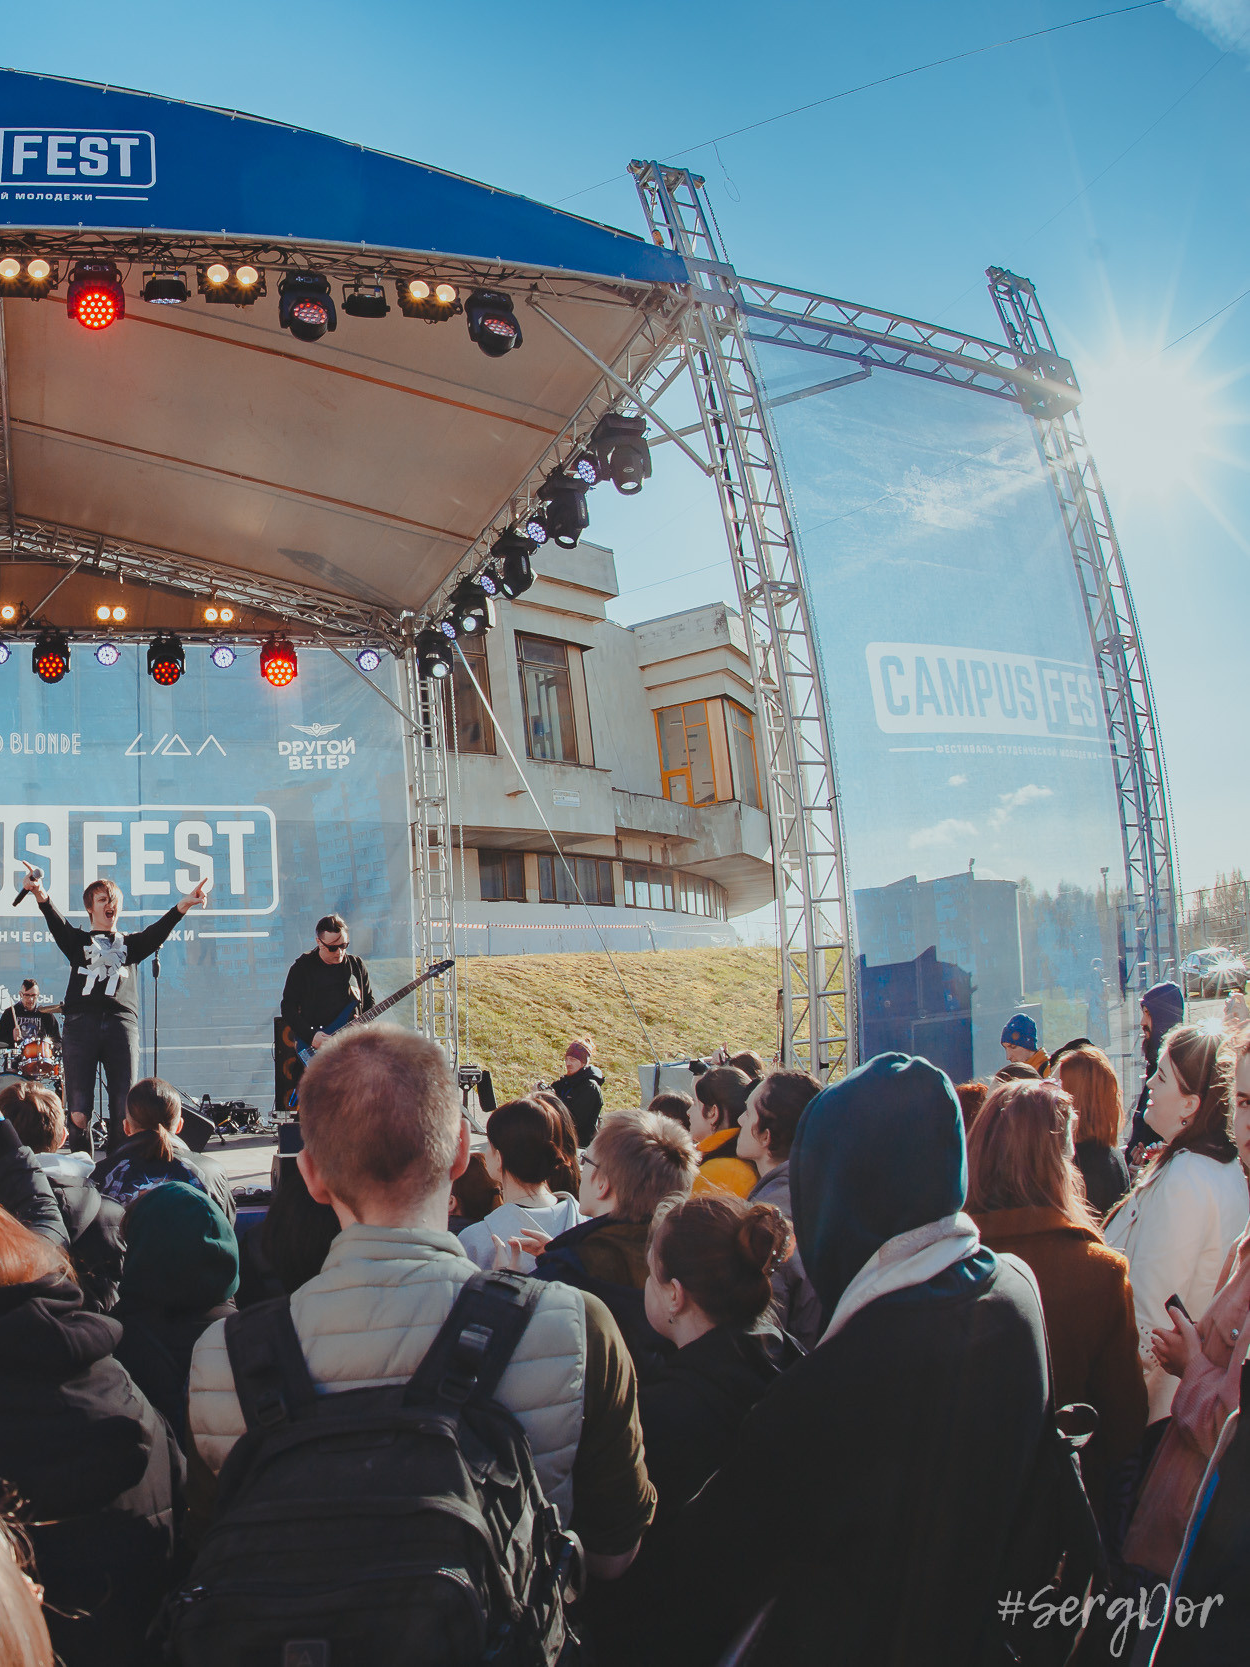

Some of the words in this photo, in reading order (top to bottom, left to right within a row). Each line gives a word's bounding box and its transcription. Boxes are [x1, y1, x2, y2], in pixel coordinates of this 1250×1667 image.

[12, 134, 140, 178] FEST
[15, 192, 93, 202] МОЛОДЕЖИ
[878, 654, 1038, 721] CAMPUS
[1041, 667, 1098, 728] FES
[10, 732, 82, 755] BLONDE
[288, 754, 351, 771] ВЕТЕР
[83, 820, 255, 896] FEST
